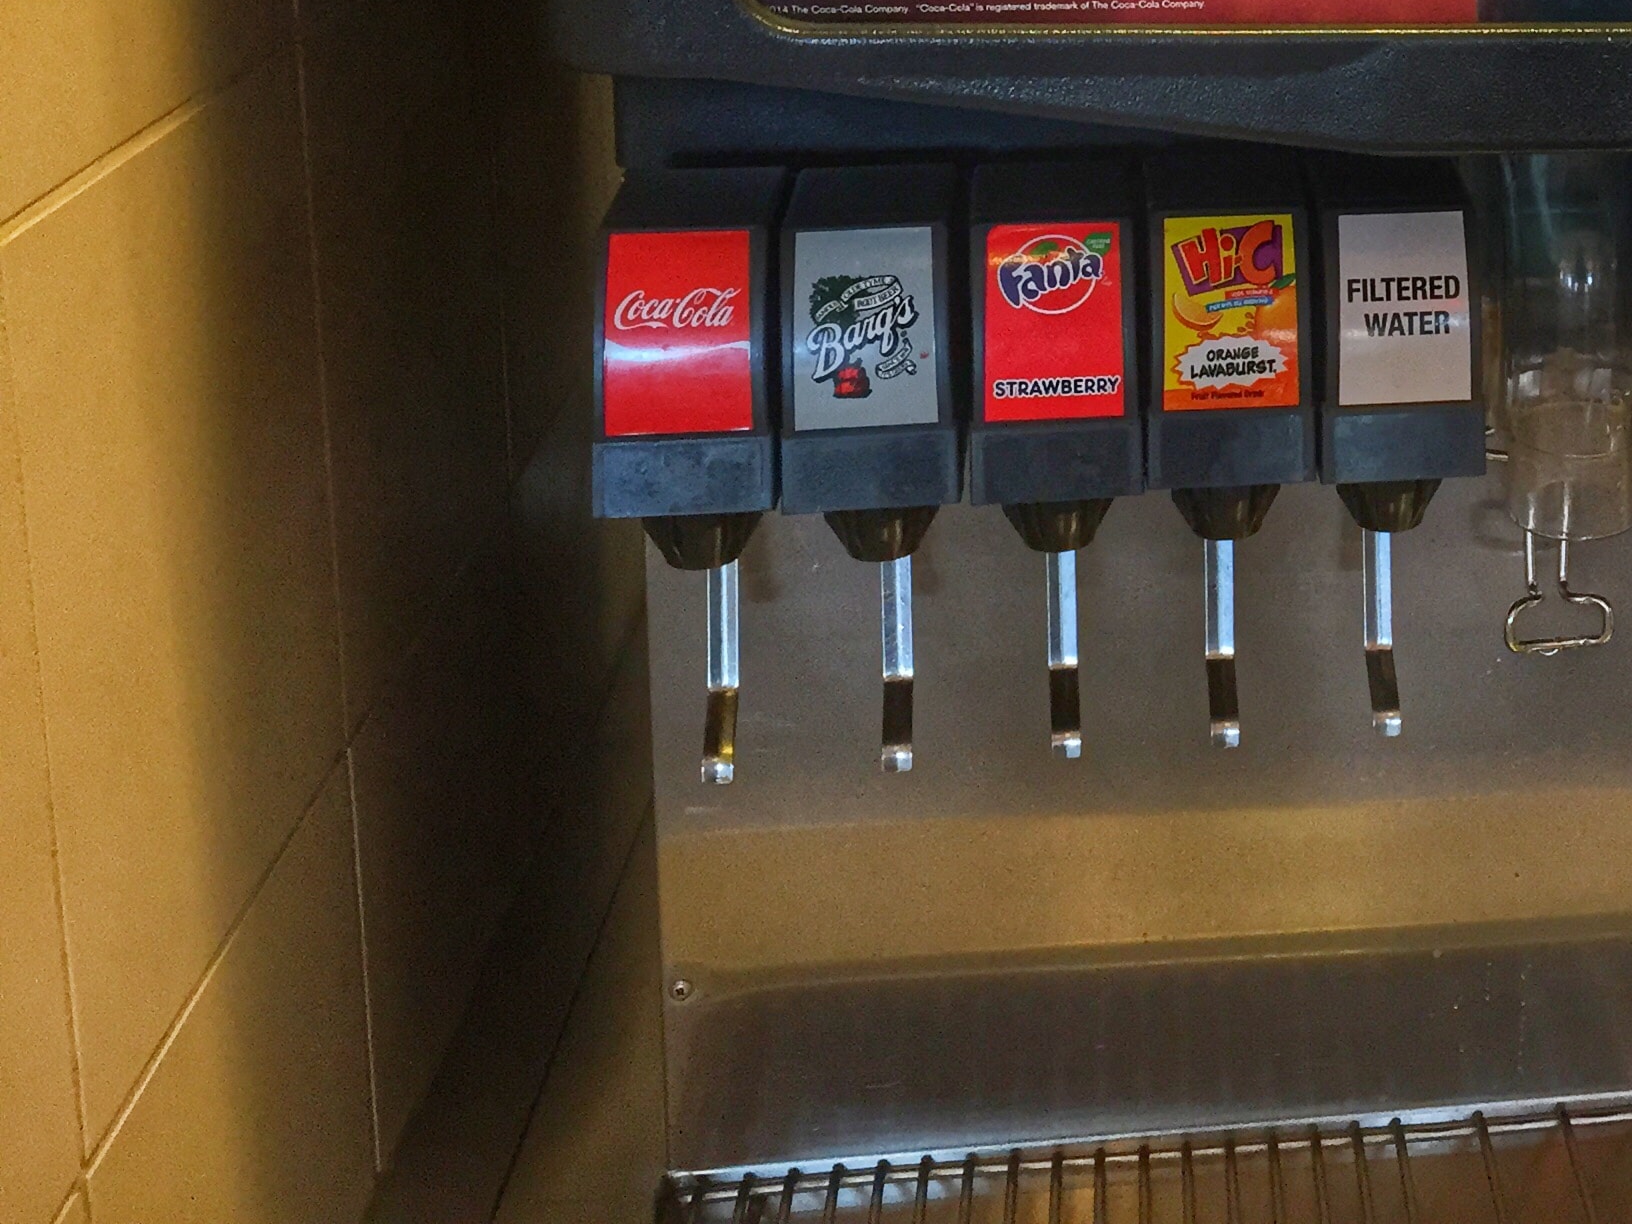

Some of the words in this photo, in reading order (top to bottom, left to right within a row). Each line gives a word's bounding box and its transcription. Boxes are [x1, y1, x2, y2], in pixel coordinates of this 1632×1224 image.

[791, 4, 809, 14] The
[811, 4, 863, 15] Coca-Cola
[975, 2, 984, 12] is
[986, 2, 1031, 13] registered
[1033, 1, 1079, 11] trademark
[1080, 1, 1090, 10] of
[1092, 0, 1109, 10] The
[1110, 0, 1160, 10] Coca-Cola
[998, 247, 1104, 310] Fanta
[1346, 274, 1461, 303] FILTERED
[613, 287, 742, 330] Coca-Cola
[1364, 310, 1451, 337] WATER
[806, 295, 918, 383] Barq's
[1206, 346, 1260, 363] ORANGE
[994, 376, 1121, 398] STRAWBERRY
